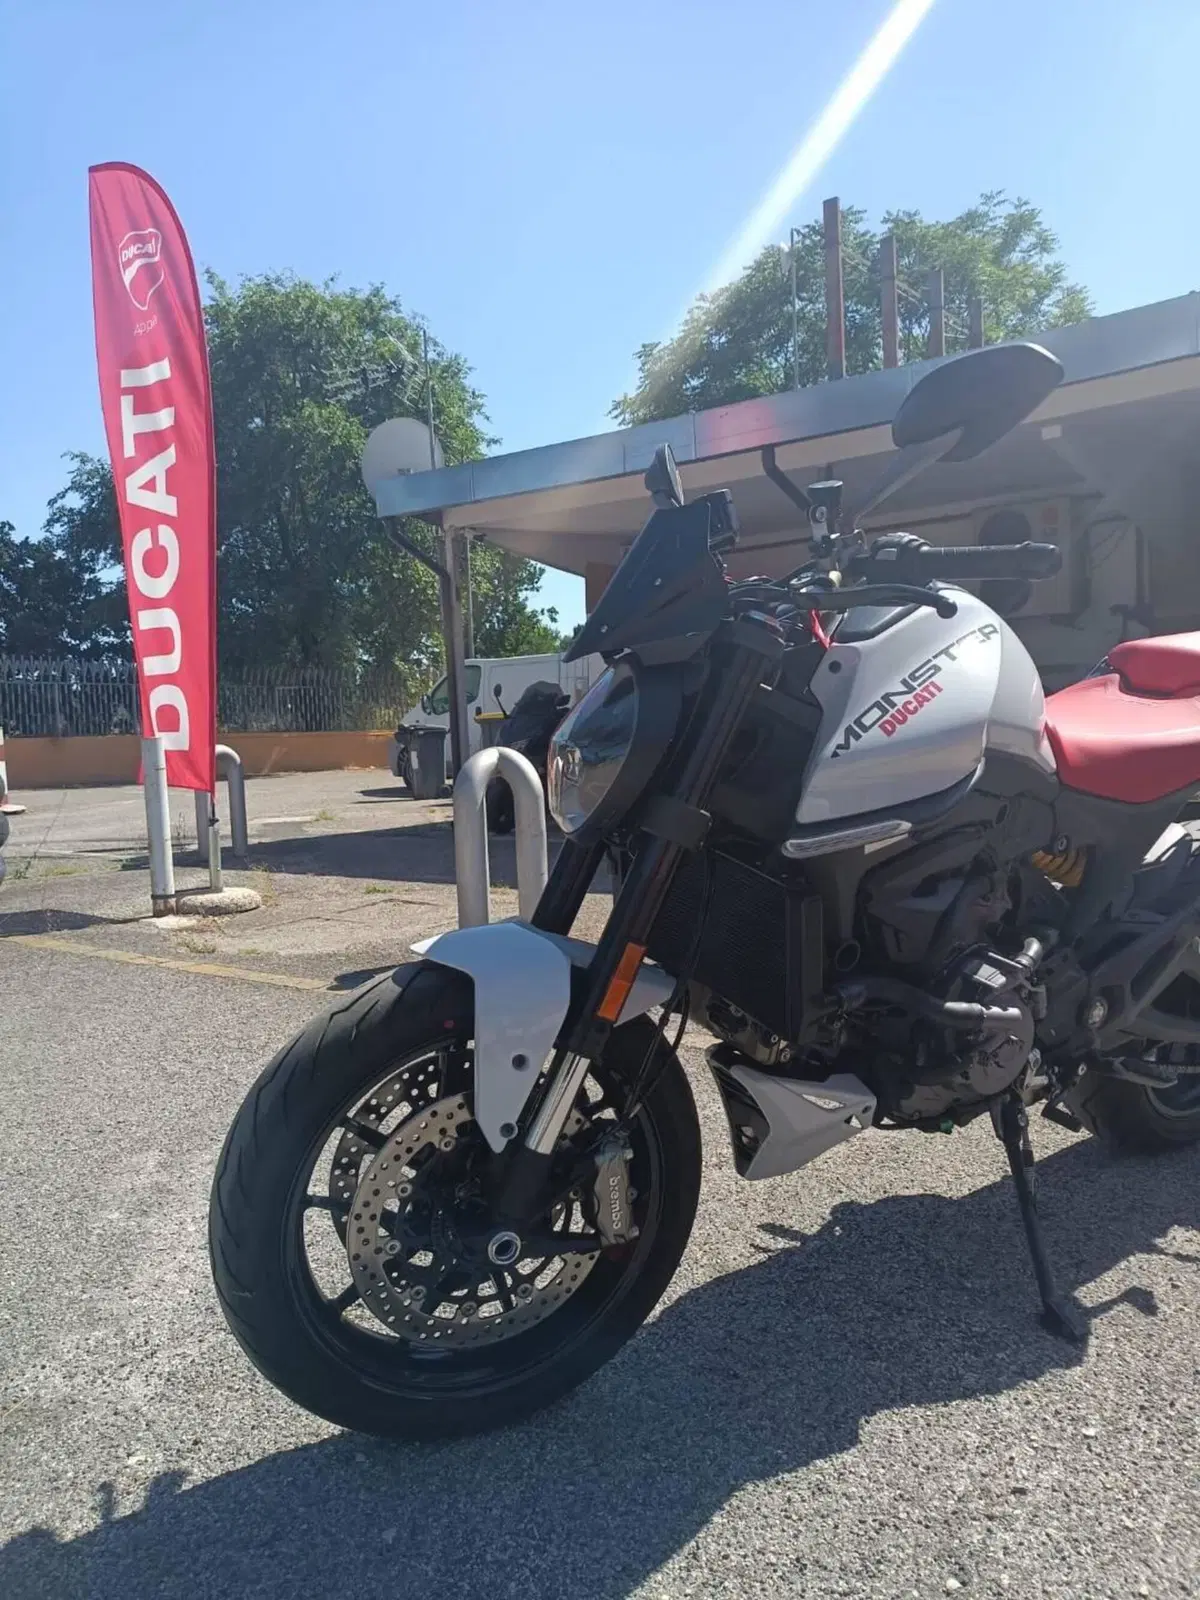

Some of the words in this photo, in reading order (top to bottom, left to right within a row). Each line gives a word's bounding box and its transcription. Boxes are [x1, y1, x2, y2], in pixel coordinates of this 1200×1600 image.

[120, 356, 190, 752] DUCATI
[878, 680, 944, 738] DUCATI
[609, 1175, 622, 1230] brembo
